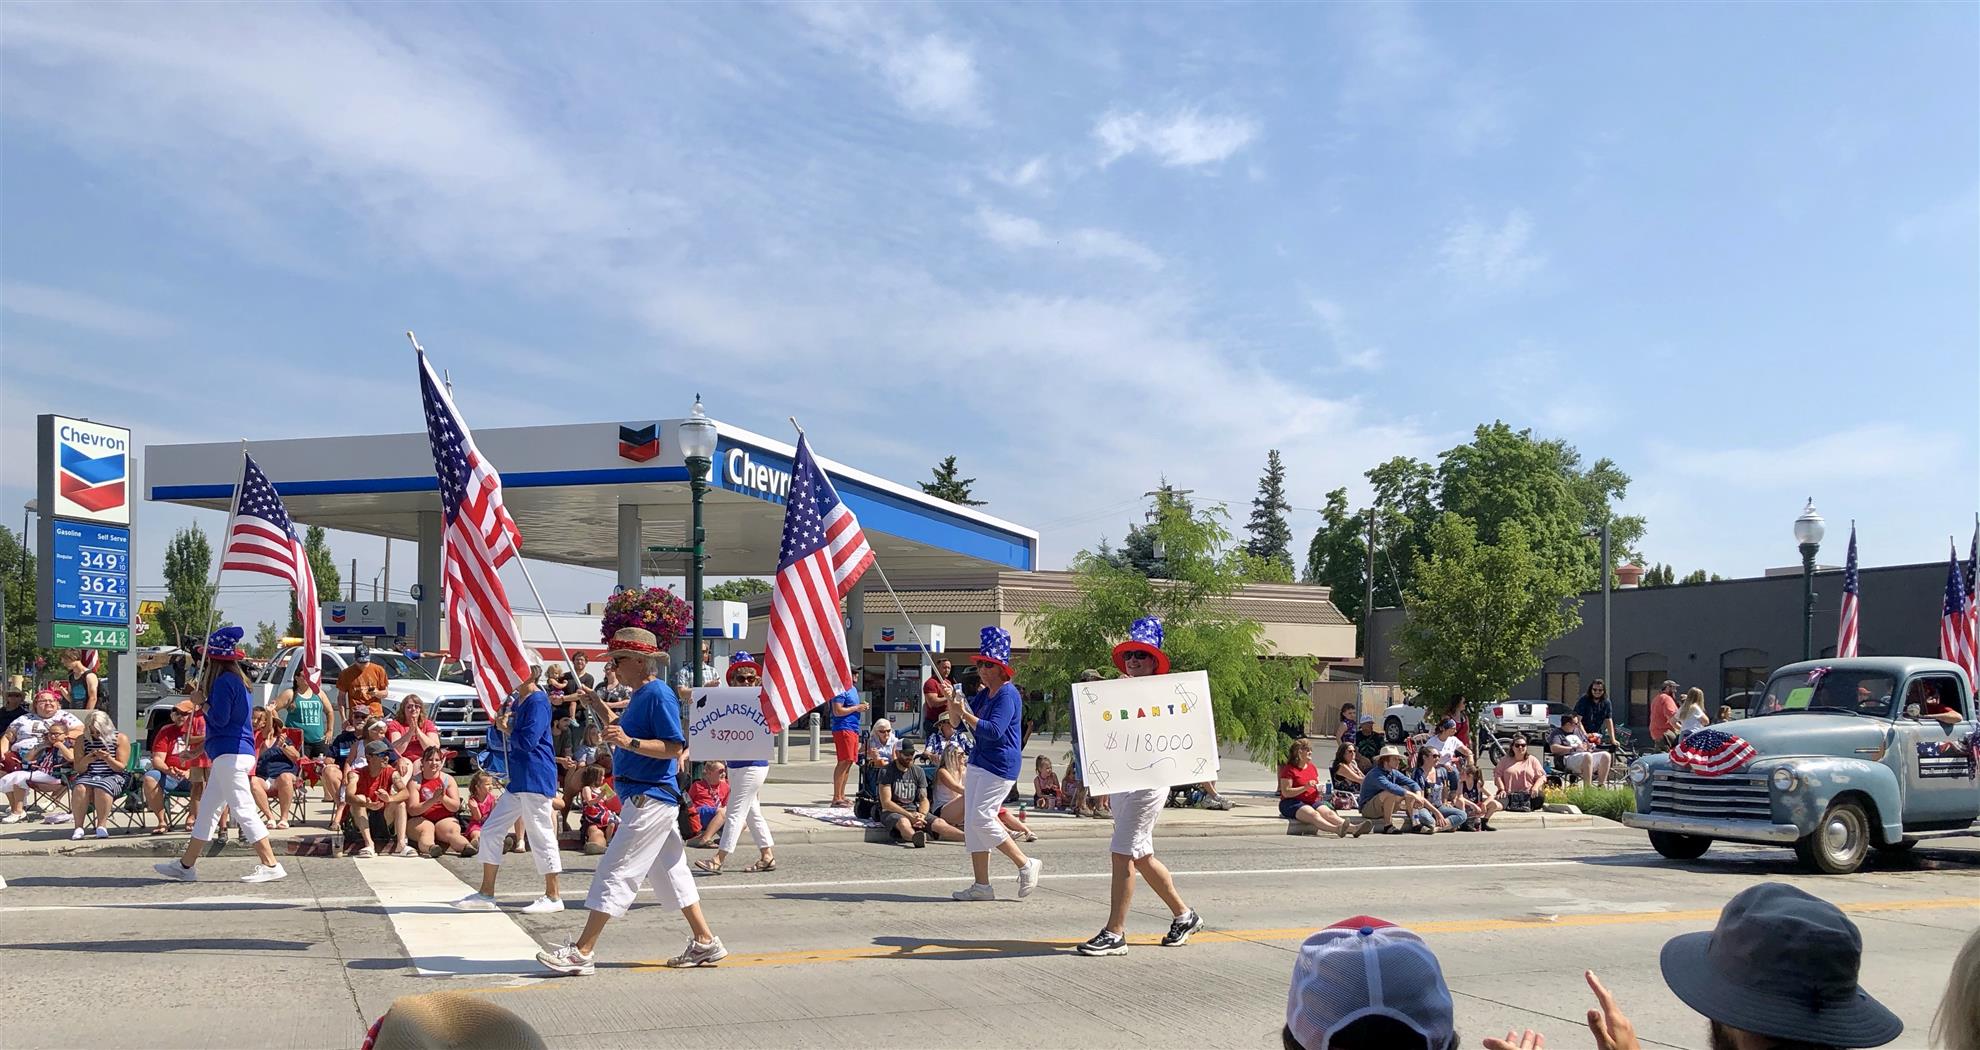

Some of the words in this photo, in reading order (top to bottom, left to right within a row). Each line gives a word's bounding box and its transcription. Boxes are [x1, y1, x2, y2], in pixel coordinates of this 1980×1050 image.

[60, 425, 125, 451] Chevron
[56, 528, 82, 537] Gasoline
[97, 533, 109, 541] Self
[110, 535, 127, 543] Serve
[80, 551, 117, 570] 349
[80, 575, 117, 593] 362
[80, 600, 117, 617] 377
[361, 605, 369, 616] 6
[81, 629, 117, 647] 344
[1103, 703, 1188, 721] GRANTS
[711, 729, 754, 744] $37,000
[1104, 732, 1193, 754] $118,000
